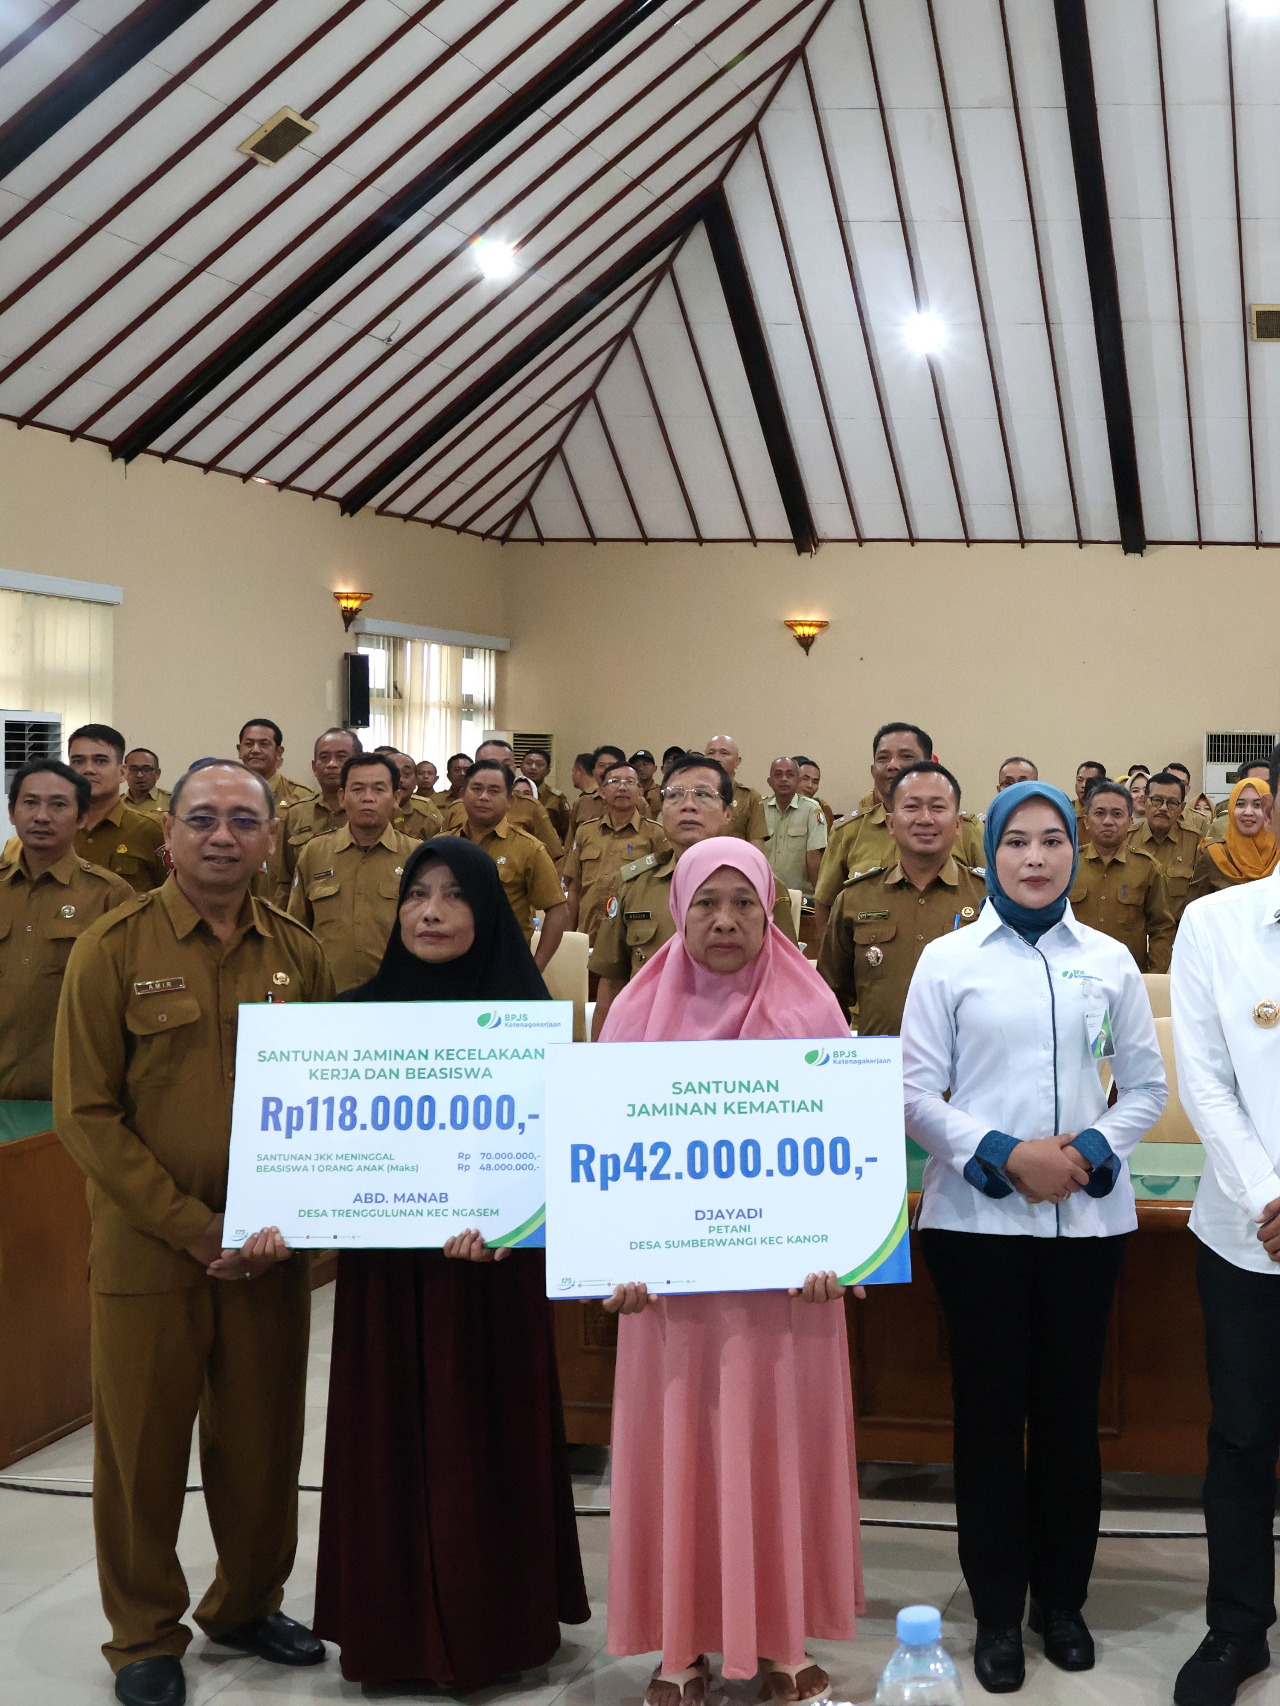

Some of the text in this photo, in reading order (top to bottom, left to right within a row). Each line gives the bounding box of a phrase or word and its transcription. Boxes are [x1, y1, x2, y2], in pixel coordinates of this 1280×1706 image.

[258, 1049, 544, 1062] SANTUNAN JAMINAN KECELAKAAN
[310, 1067, 492, 1080] KERJA DAN BEASISWA
[672, 1080, 778, 1095] SANTUNAN
[627, 1100, 823, 1117] JAMINAN KEMATIAN
[261, 1095, 539, 1139] Rp118.000.000,-
[458, 1152, 471, 1161] Rp
[480, 1152, 540, 1160] 70.000.000,-
[387, 1164, 418, 1173] (Maks)
[458, 1164, 470, 1172] Rp
[571, 1137, 877, 1191] Rp42.000.000,-
[353, 1193, 448, 1203] ABD. MANAB
[331, 1209, 423, 1217] TRENGGULUNAN
[427, 1209, 448, 1217] KEC
[695, 1208, 762, 1220] DJAYADI
[709, 1225, 750, 1234] PETANI
[630, 1235, 828, 1250] DESA SUMBERWANGI KEC KANOR
